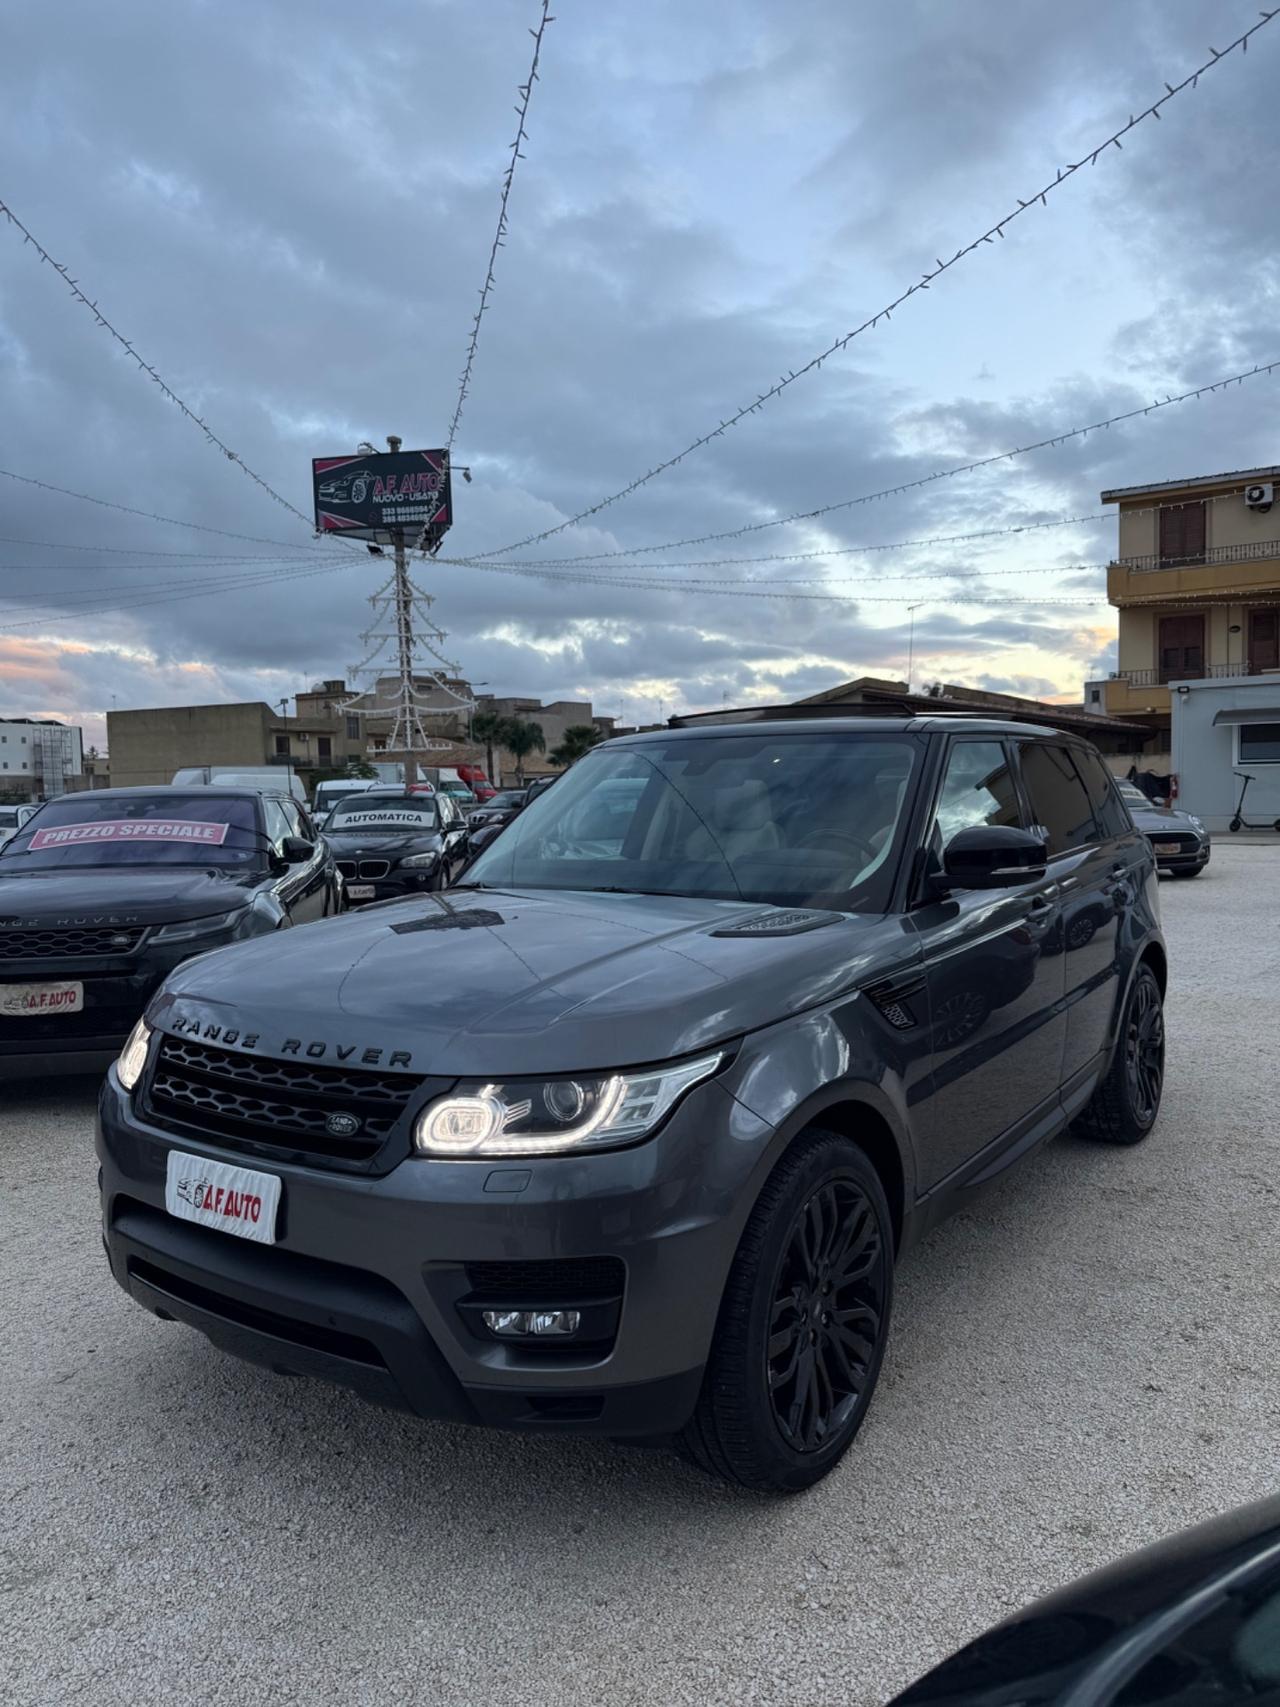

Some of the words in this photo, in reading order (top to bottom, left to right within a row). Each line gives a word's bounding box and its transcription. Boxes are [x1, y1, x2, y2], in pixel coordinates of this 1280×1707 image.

[400, 472, 439, 493] AUTO
[372, 493, 404, 503] NUOVO
[409, 491, 439, 501] USATO
[345, 813, 423, 824] AUTOMATICA
[41, 825, 114, 845] PREZZO
[119, 824, 216, 839] SPECIALE
[172, 1016, 260, 1049] RANGE
[280, 1038, 413, 1068] ROVER
